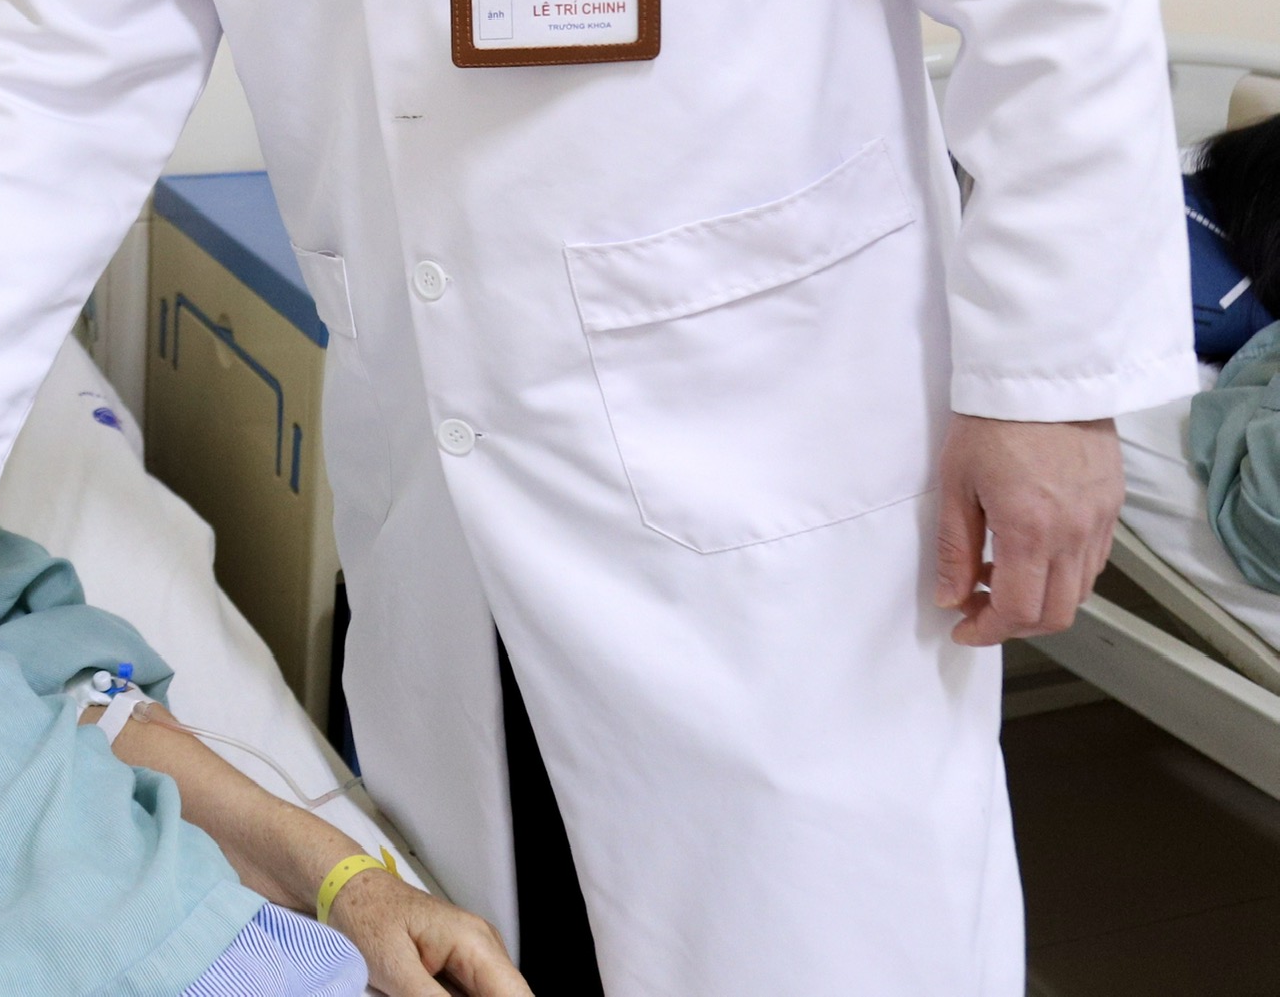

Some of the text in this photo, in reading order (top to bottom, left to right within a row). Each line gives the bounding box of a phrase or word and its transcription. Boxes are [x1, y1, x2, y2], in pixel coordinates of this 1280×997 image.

[533, 0, 626, 17] LÊ TRÍ CHINH
[587, 21, 612, 29] KHOA
